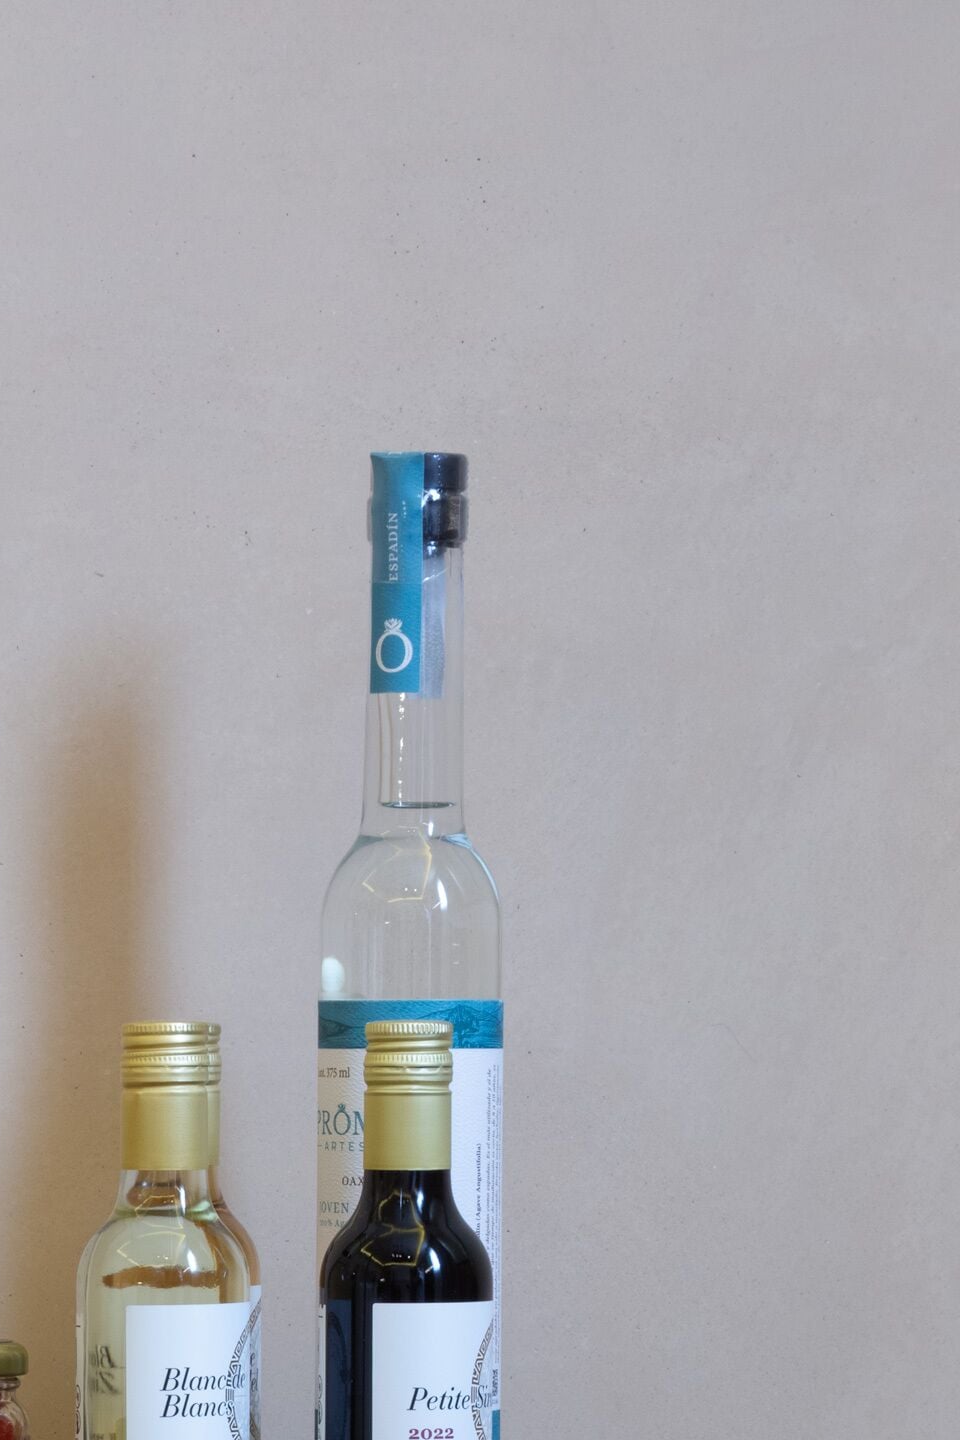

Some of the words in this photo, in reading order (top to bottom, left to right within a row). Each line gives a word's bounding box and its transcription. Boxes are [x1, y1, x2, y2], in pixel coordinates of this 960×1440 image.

[386, 512, 398, 581] ESPADÍN
[327, 1067, 337, 1078] 375
[339, 1066, 350, 1078] ml
[320, 1200, 349, 1214] OVEN
[159, 1366, 226, 1392] Blanc
[159, 1393, 234, 1418] Blancs
[406, 1386, 471, 1411] Petite
[408, 1427, 454, 1440] 2022
